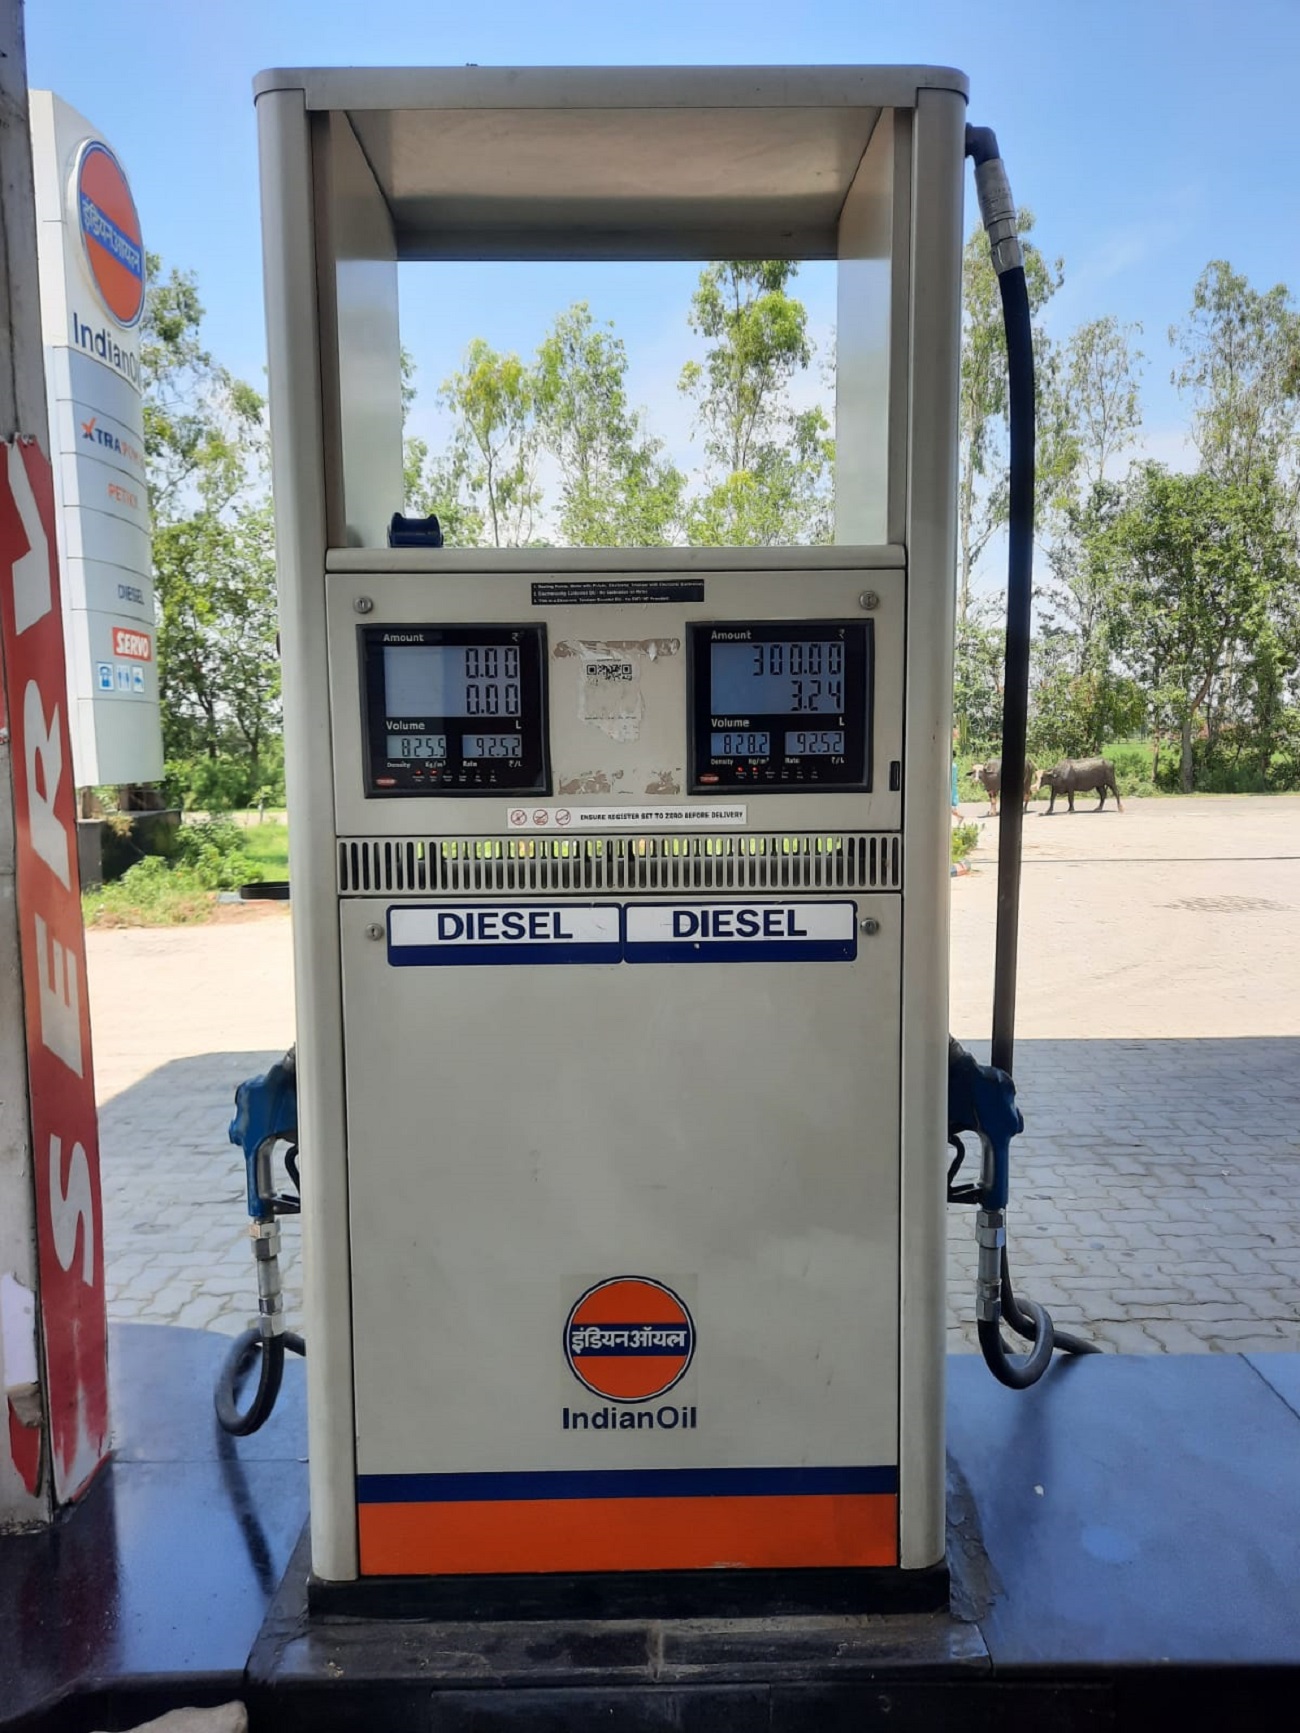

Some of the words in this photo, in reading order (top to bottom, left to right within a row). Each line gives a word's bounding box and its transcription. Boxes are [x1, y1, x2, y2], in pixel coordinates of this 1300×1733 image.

[116, 630, 151, 659] SERVO
[383, 633, 425, 642] Amount
[711, 630, 752, 640] Amount
[466, 647, 518, 679] 0.00
[752, 643, 842, 676] 300.00
[466, 684, 519, 715] 0.00
[791, 679, 841, 711] 3.24
[385, 720, 426, 730] Volume
[515, 720, 522, 729] L
[711, 718, 750, 728] Volume
[838, 716, 845, 726] L
[386, 761, 411, 769] Density
[711, 758, 734, 766] Density
[640, 812, 653, 820] SET
[684, 811, 710, 819] BEFORE
[437, 911, 573, 941] DIESEL
[672, 908, 808, 938] DIESEL
[571, 1326, 688, 1354] इंडियनऑयल
[562, 1405, 698, 1430] IndianOil
